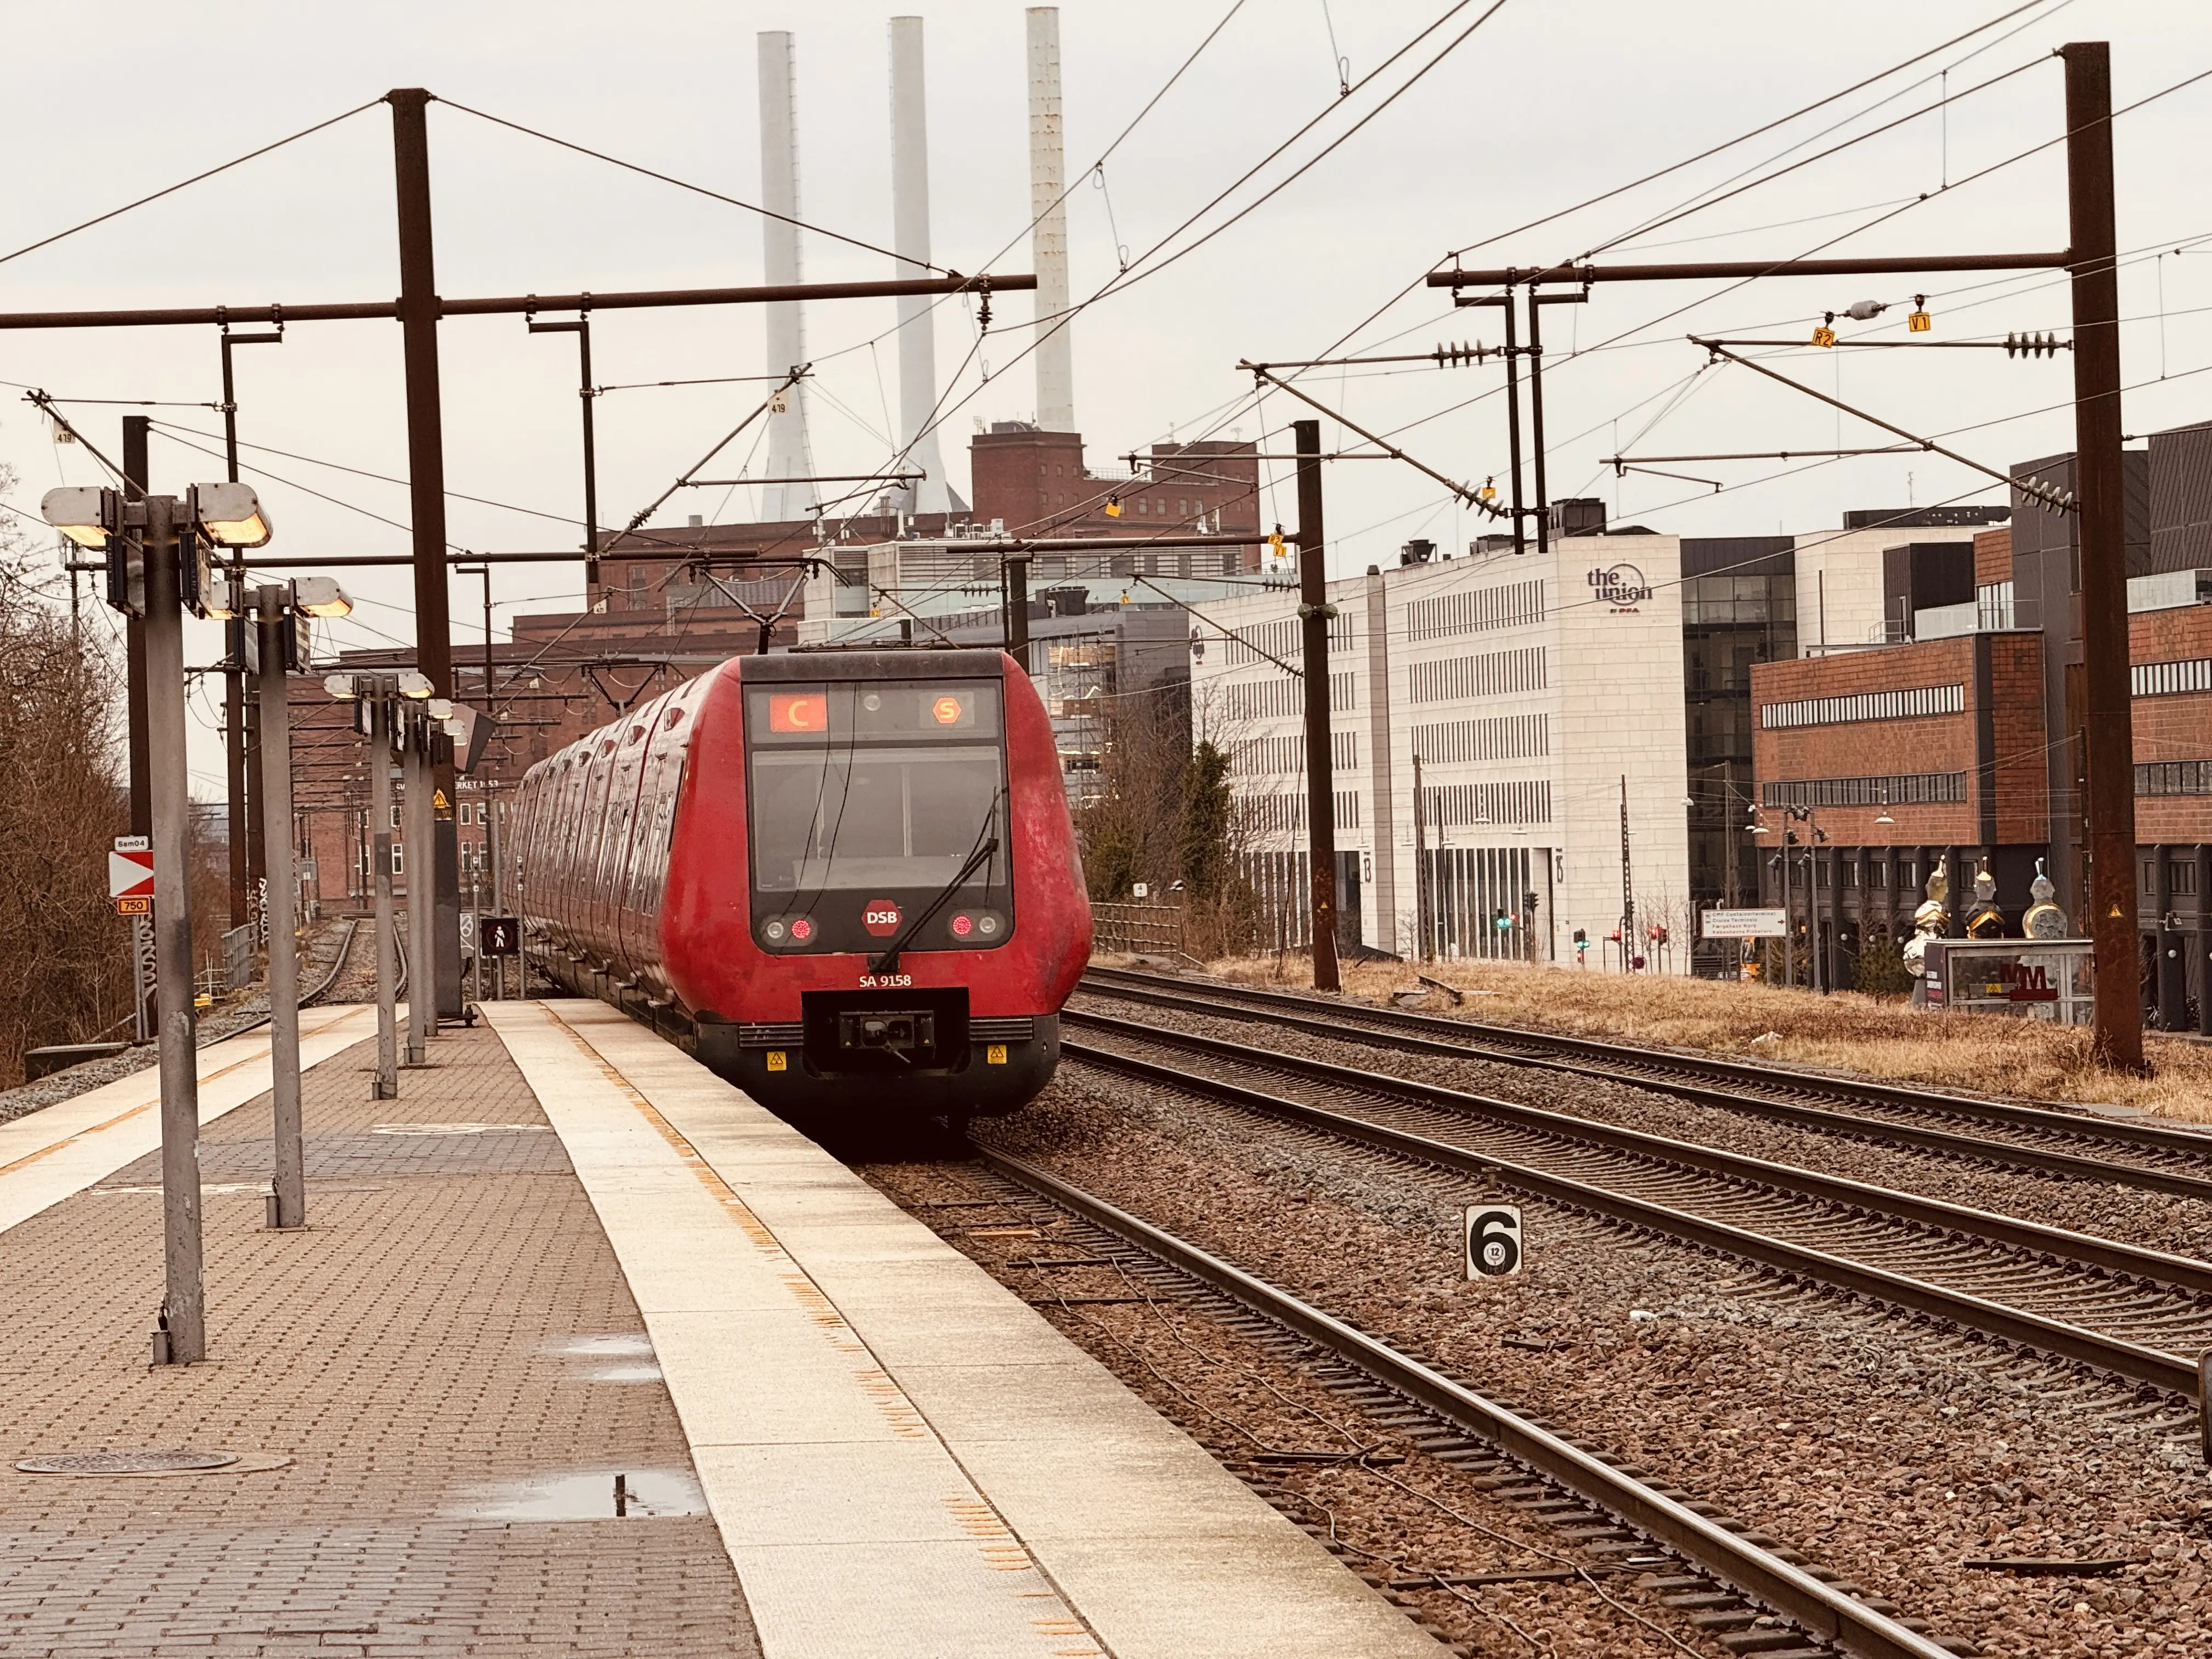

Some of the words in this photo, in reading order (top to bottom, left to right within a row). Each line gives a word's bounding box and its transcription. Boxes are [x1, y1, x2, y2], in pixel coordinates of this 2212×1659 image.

[1912, 317, 1927, 330] V1
[1815, 331, 1831, 346] R2
[1587, 568, 1620, 586] the
[1595, 583, 1652, 600] union
[788, 701, 808, 726] C
[939, 702, 955, 718] S
[125, 902, 143, 910] 750
[867, 911, 898, 924] DSB
[860, 976, 877, 988] SA
[881, 975, 911, 987] 9158
[1470, 1211, 1518, 1276] 6
[1491, 1248, 1500, 1256] 12
